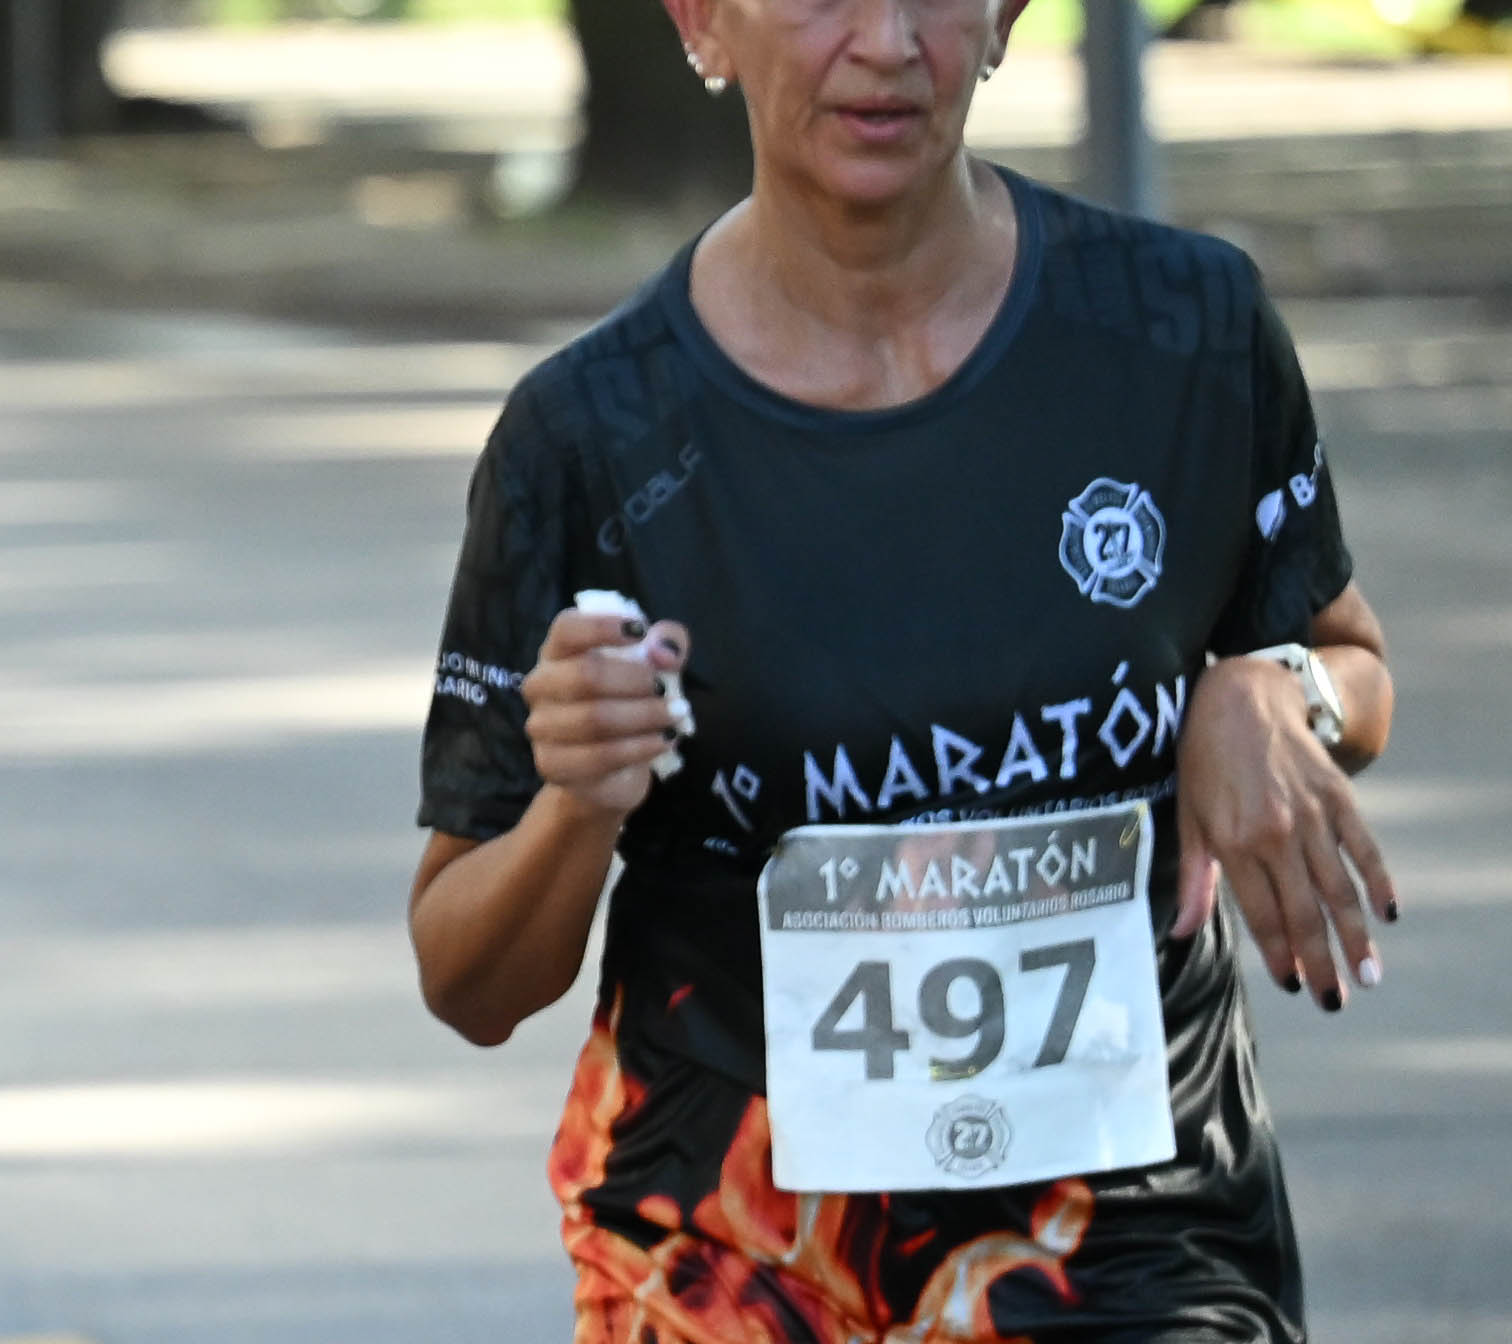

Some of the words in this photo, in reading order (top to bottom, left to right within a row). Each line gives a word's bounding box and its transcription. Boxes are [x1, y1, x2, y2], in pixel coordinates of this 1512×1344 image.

[803, 661, 1188, 822] MARATÓN
[782, 907, 880, 929] ASOCIACIÓN
[881, 907, 970, 929] BOMBEROS
[973, 893, 1067, 925] VOLUNTARIOS
[1070, 880, 1130, 910] ROSARIO
[875, 829, 1098, 902] MARATÓN
[811, 937, 1097, 1082] 497
